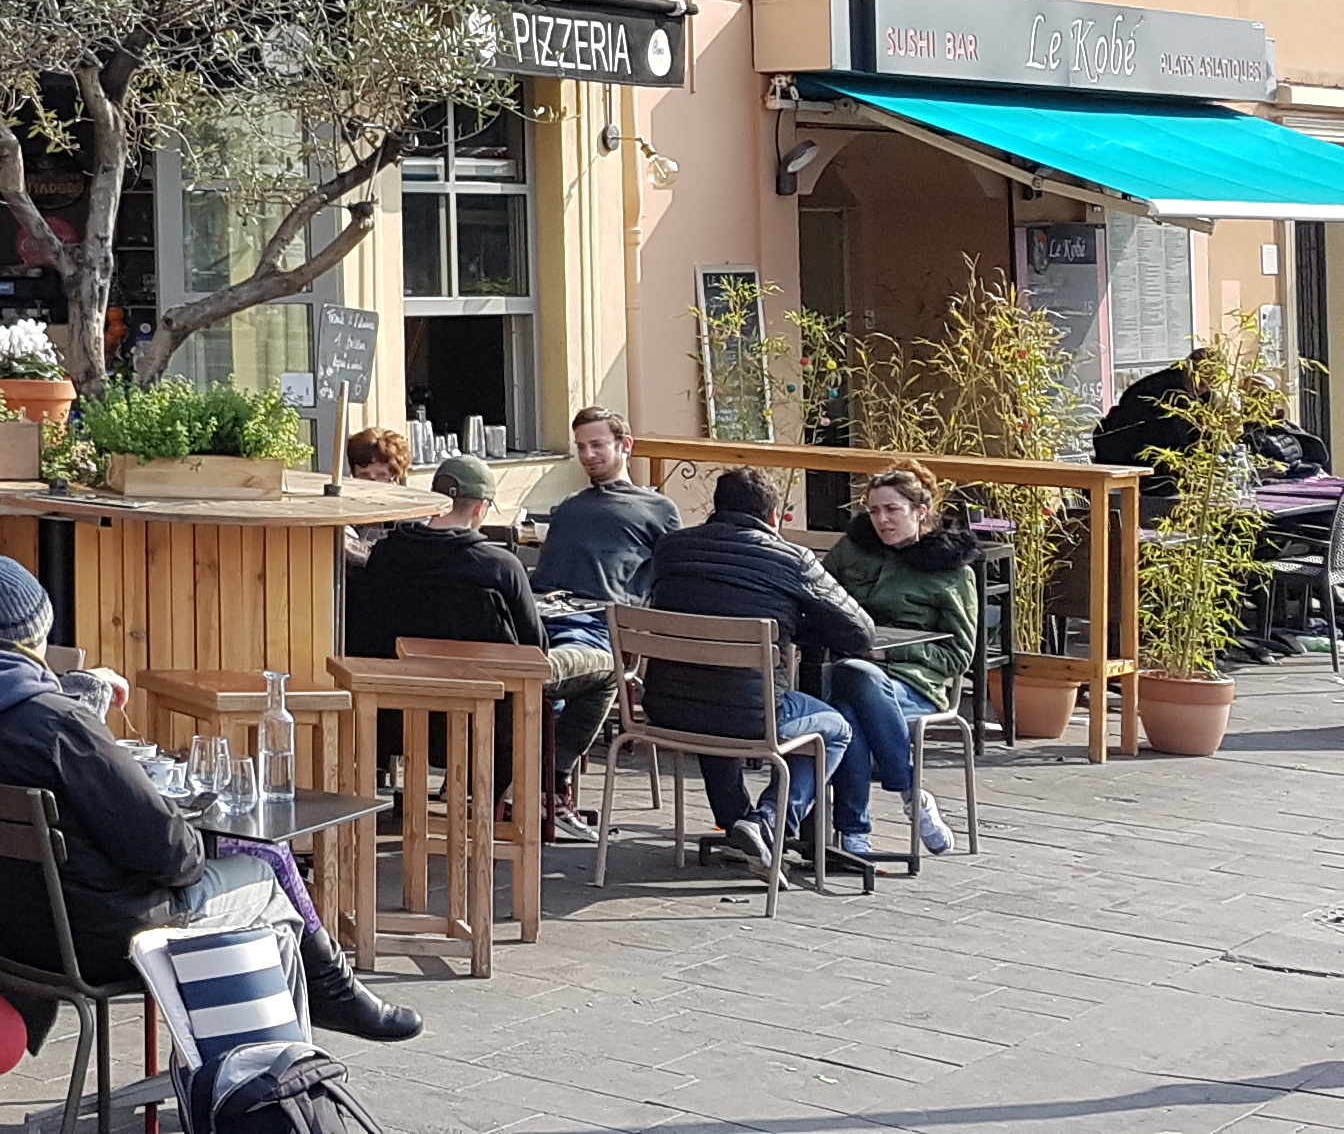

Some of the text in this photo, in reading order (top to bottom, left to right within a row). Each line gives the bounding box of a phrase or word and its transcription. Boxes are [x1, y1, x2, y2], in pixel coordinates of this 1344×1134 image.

[512, 11, 632, 75] PIZZERIA
[886, 26, 980, 62] SUSHI BAR
[1025, 13, 1145, 84] Le Kobé
[1160, 52, 1263, 84] PLATS ASIATIQUES
